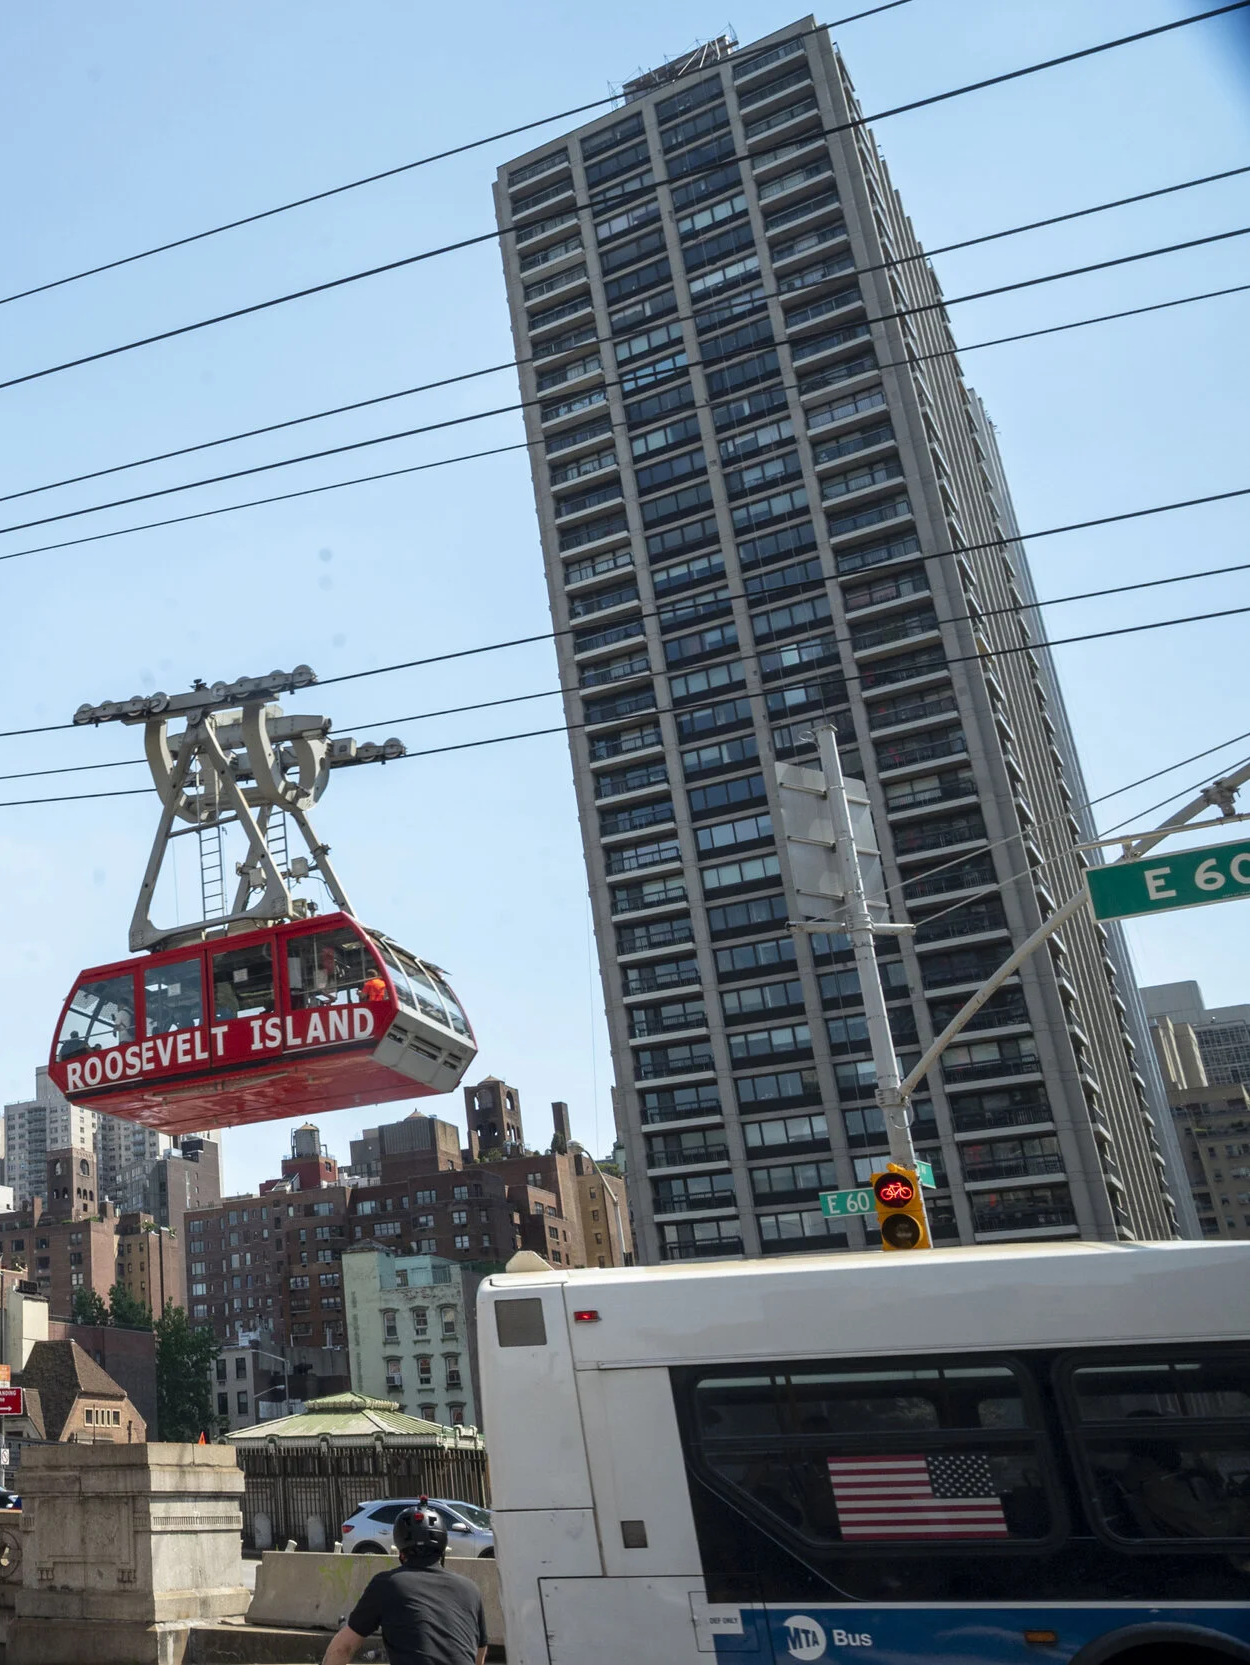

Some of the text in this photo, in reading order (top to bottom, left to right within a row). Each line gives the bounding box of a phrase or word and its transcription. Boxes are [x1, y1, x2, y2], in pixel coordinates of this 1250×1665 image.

[1144, 866, 1177, 900] E
[66, 1008, 375, 1091] ROOSEVELT ISLAND
[827, 1191, 870, 1214] E 60
[787, 1626, 873, 1650] MTA Bus
